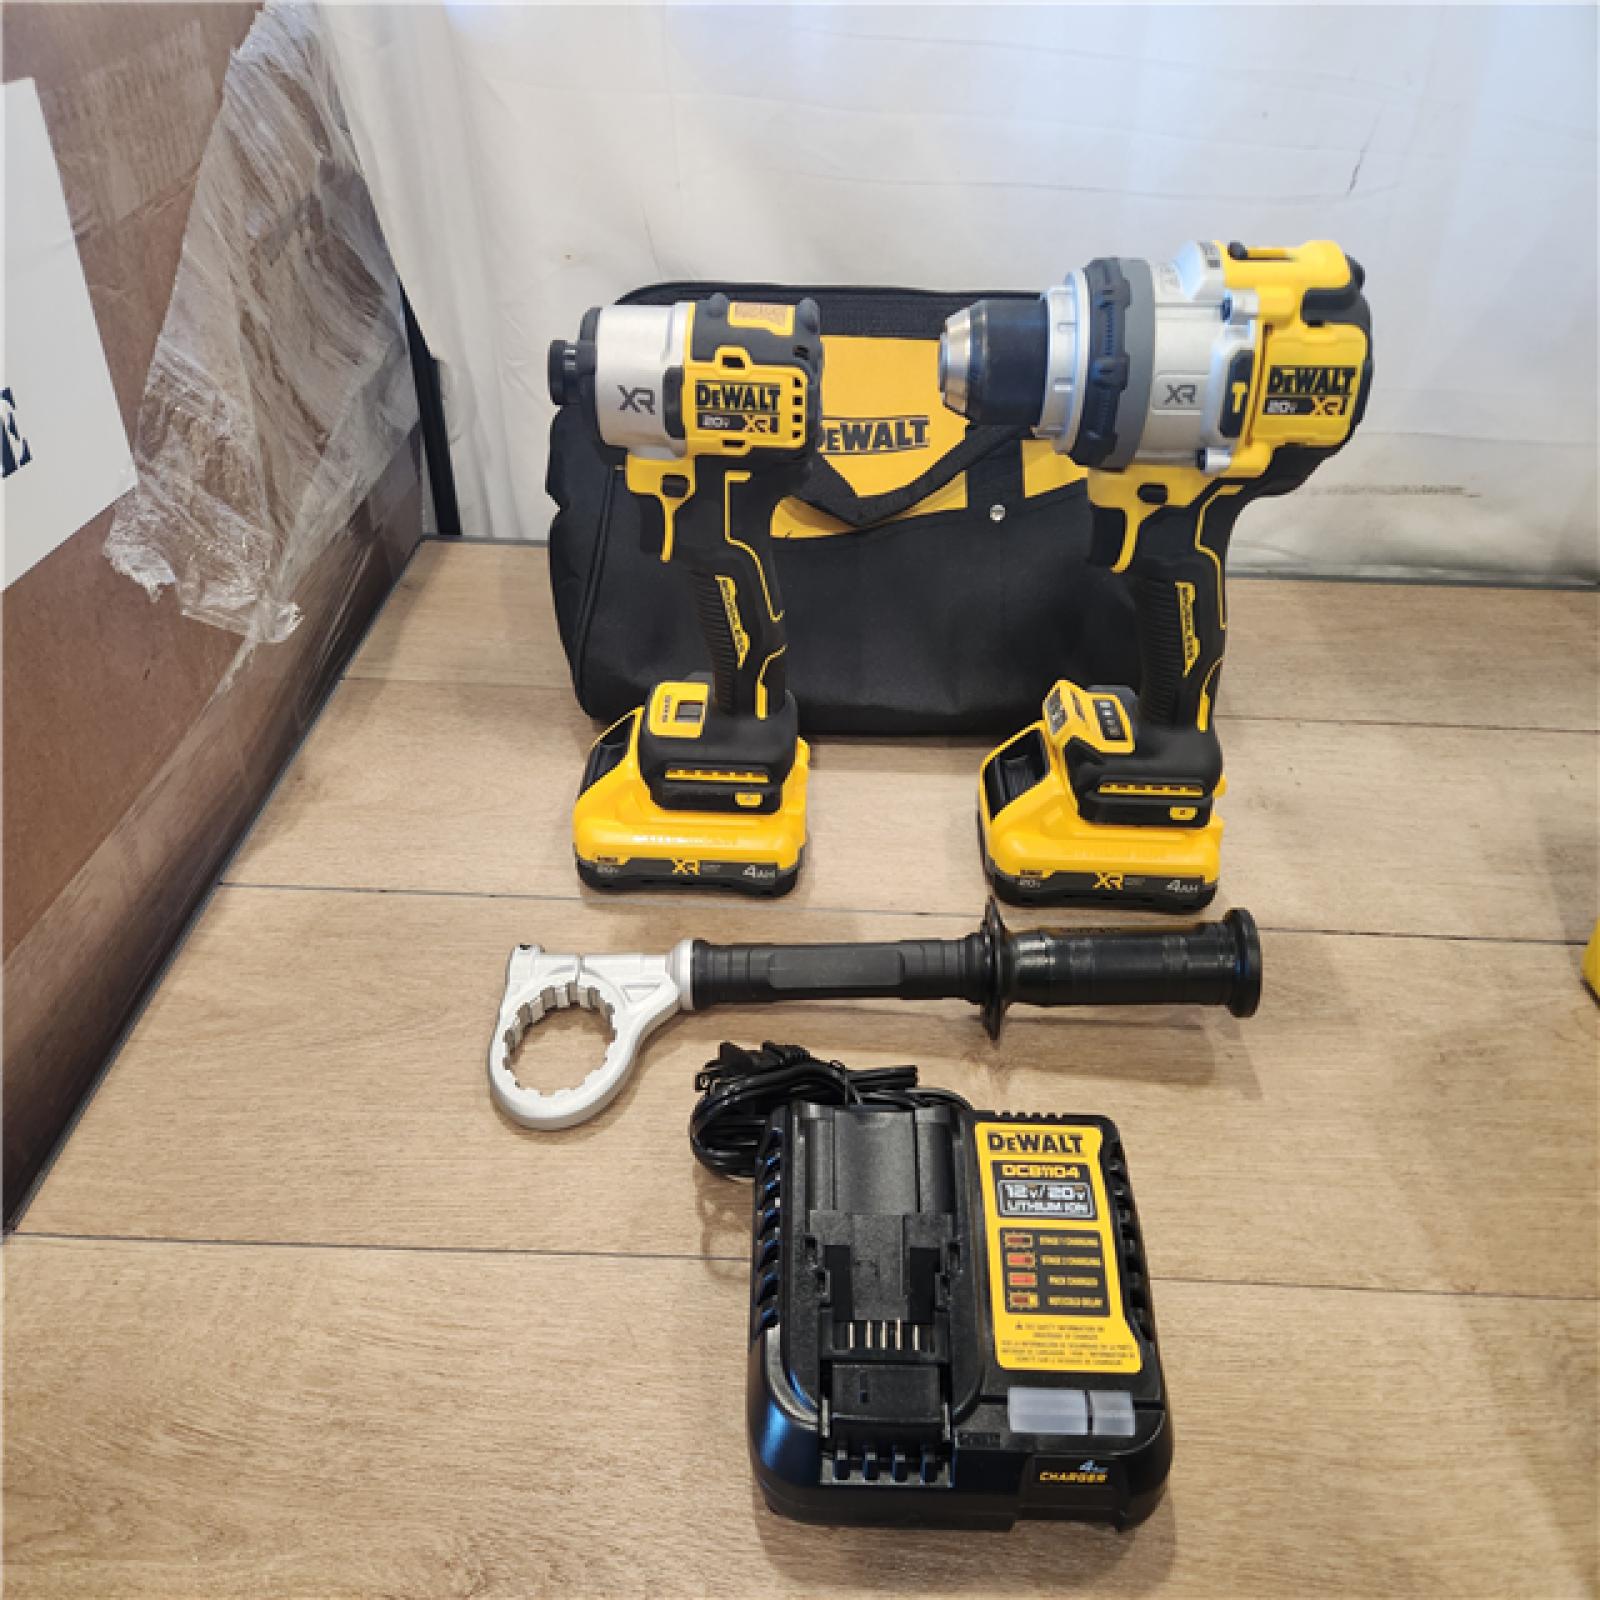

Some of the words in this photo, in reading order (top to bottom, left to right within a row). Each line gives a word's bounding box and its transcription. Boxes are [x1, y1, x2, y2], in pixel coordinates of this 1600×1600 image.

[617, 384, 656, 415] XR
[1164, 384, 1198, 405] XR
[987, 1133, 1084, 1154] DEWALT
